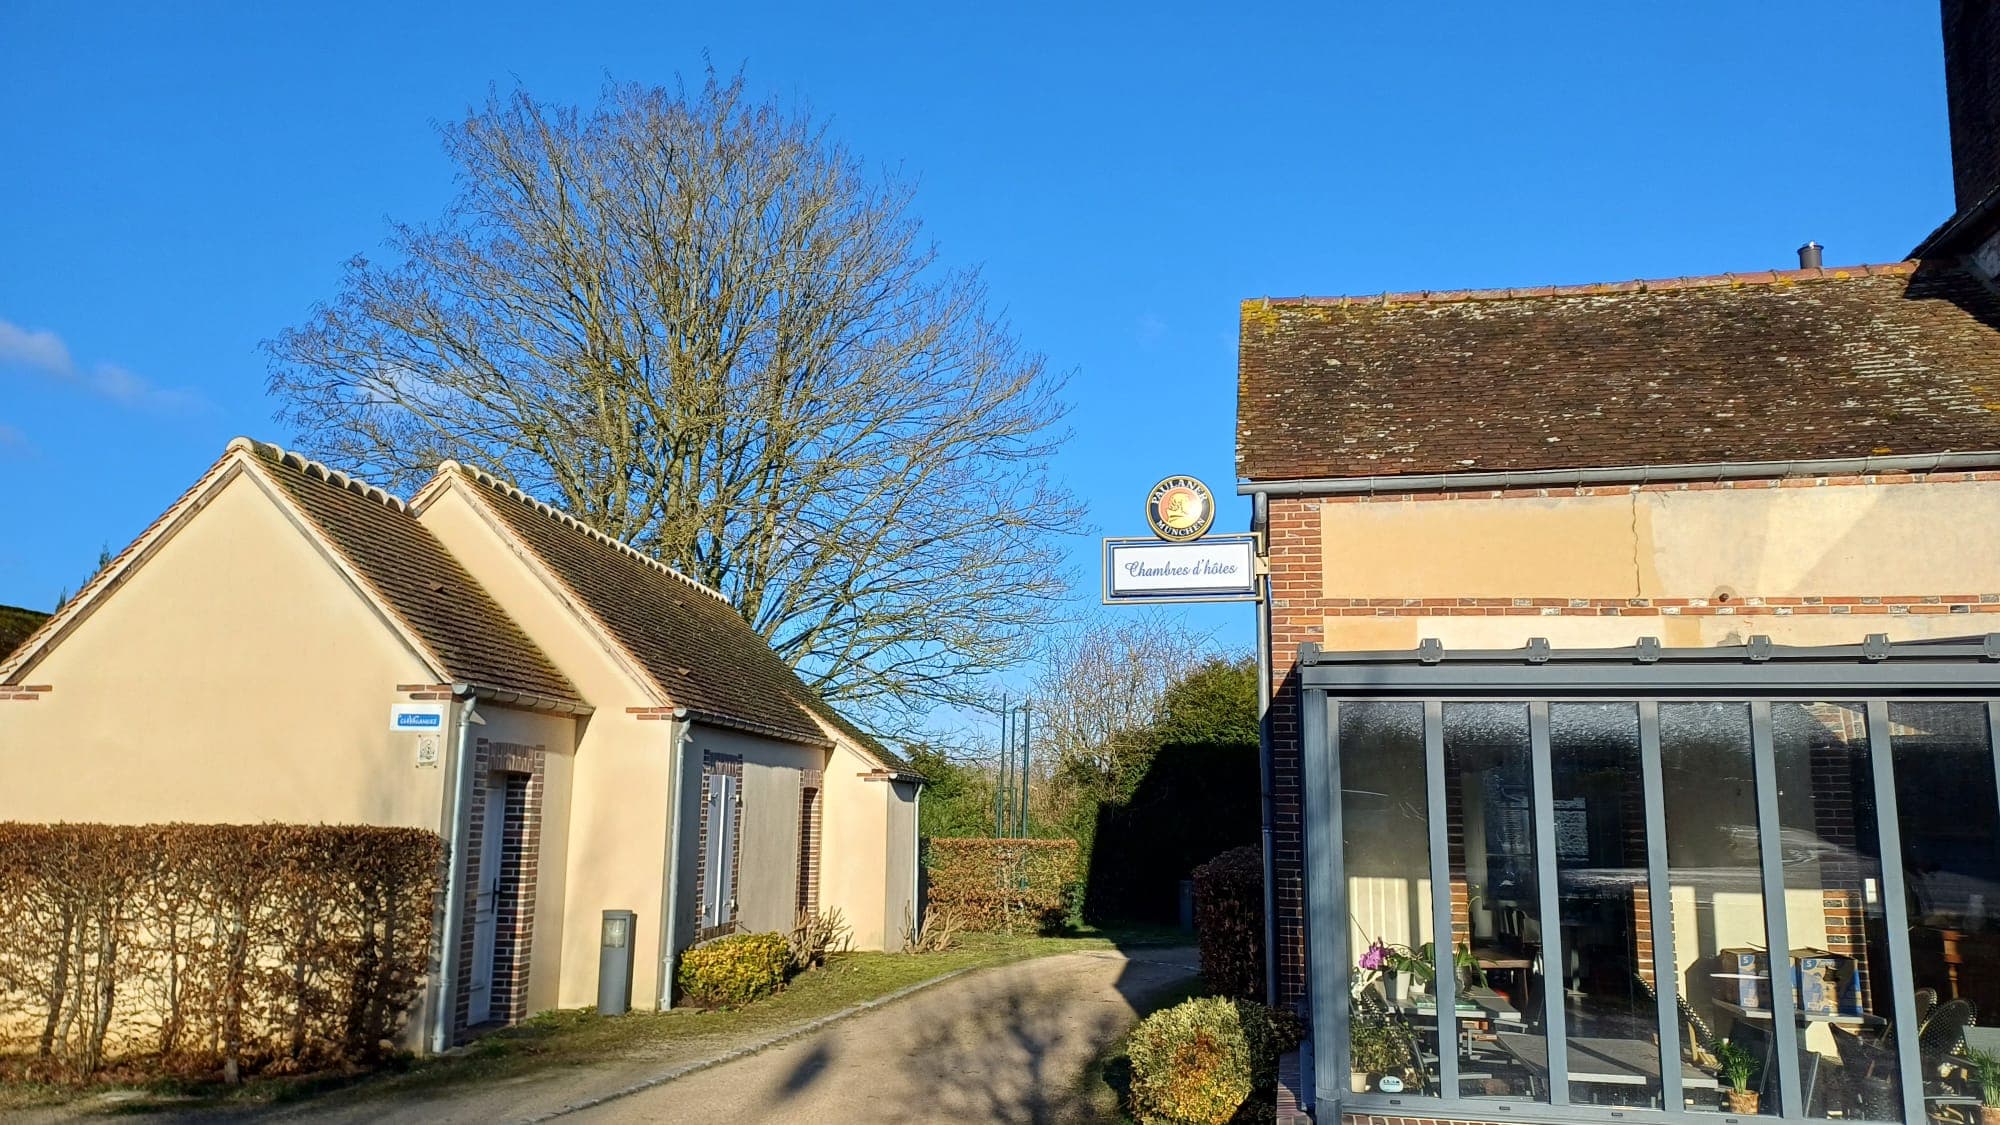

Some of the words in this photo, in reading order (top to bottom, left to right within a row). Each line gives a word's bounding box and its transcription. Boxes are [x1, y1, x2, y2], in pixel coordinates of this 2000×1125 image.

[1151, 479, 1208, 504] PAULANER
[1124, 560, 1190, 577] Chambres
[1192, 559, 1238, 576] d'hôtes
